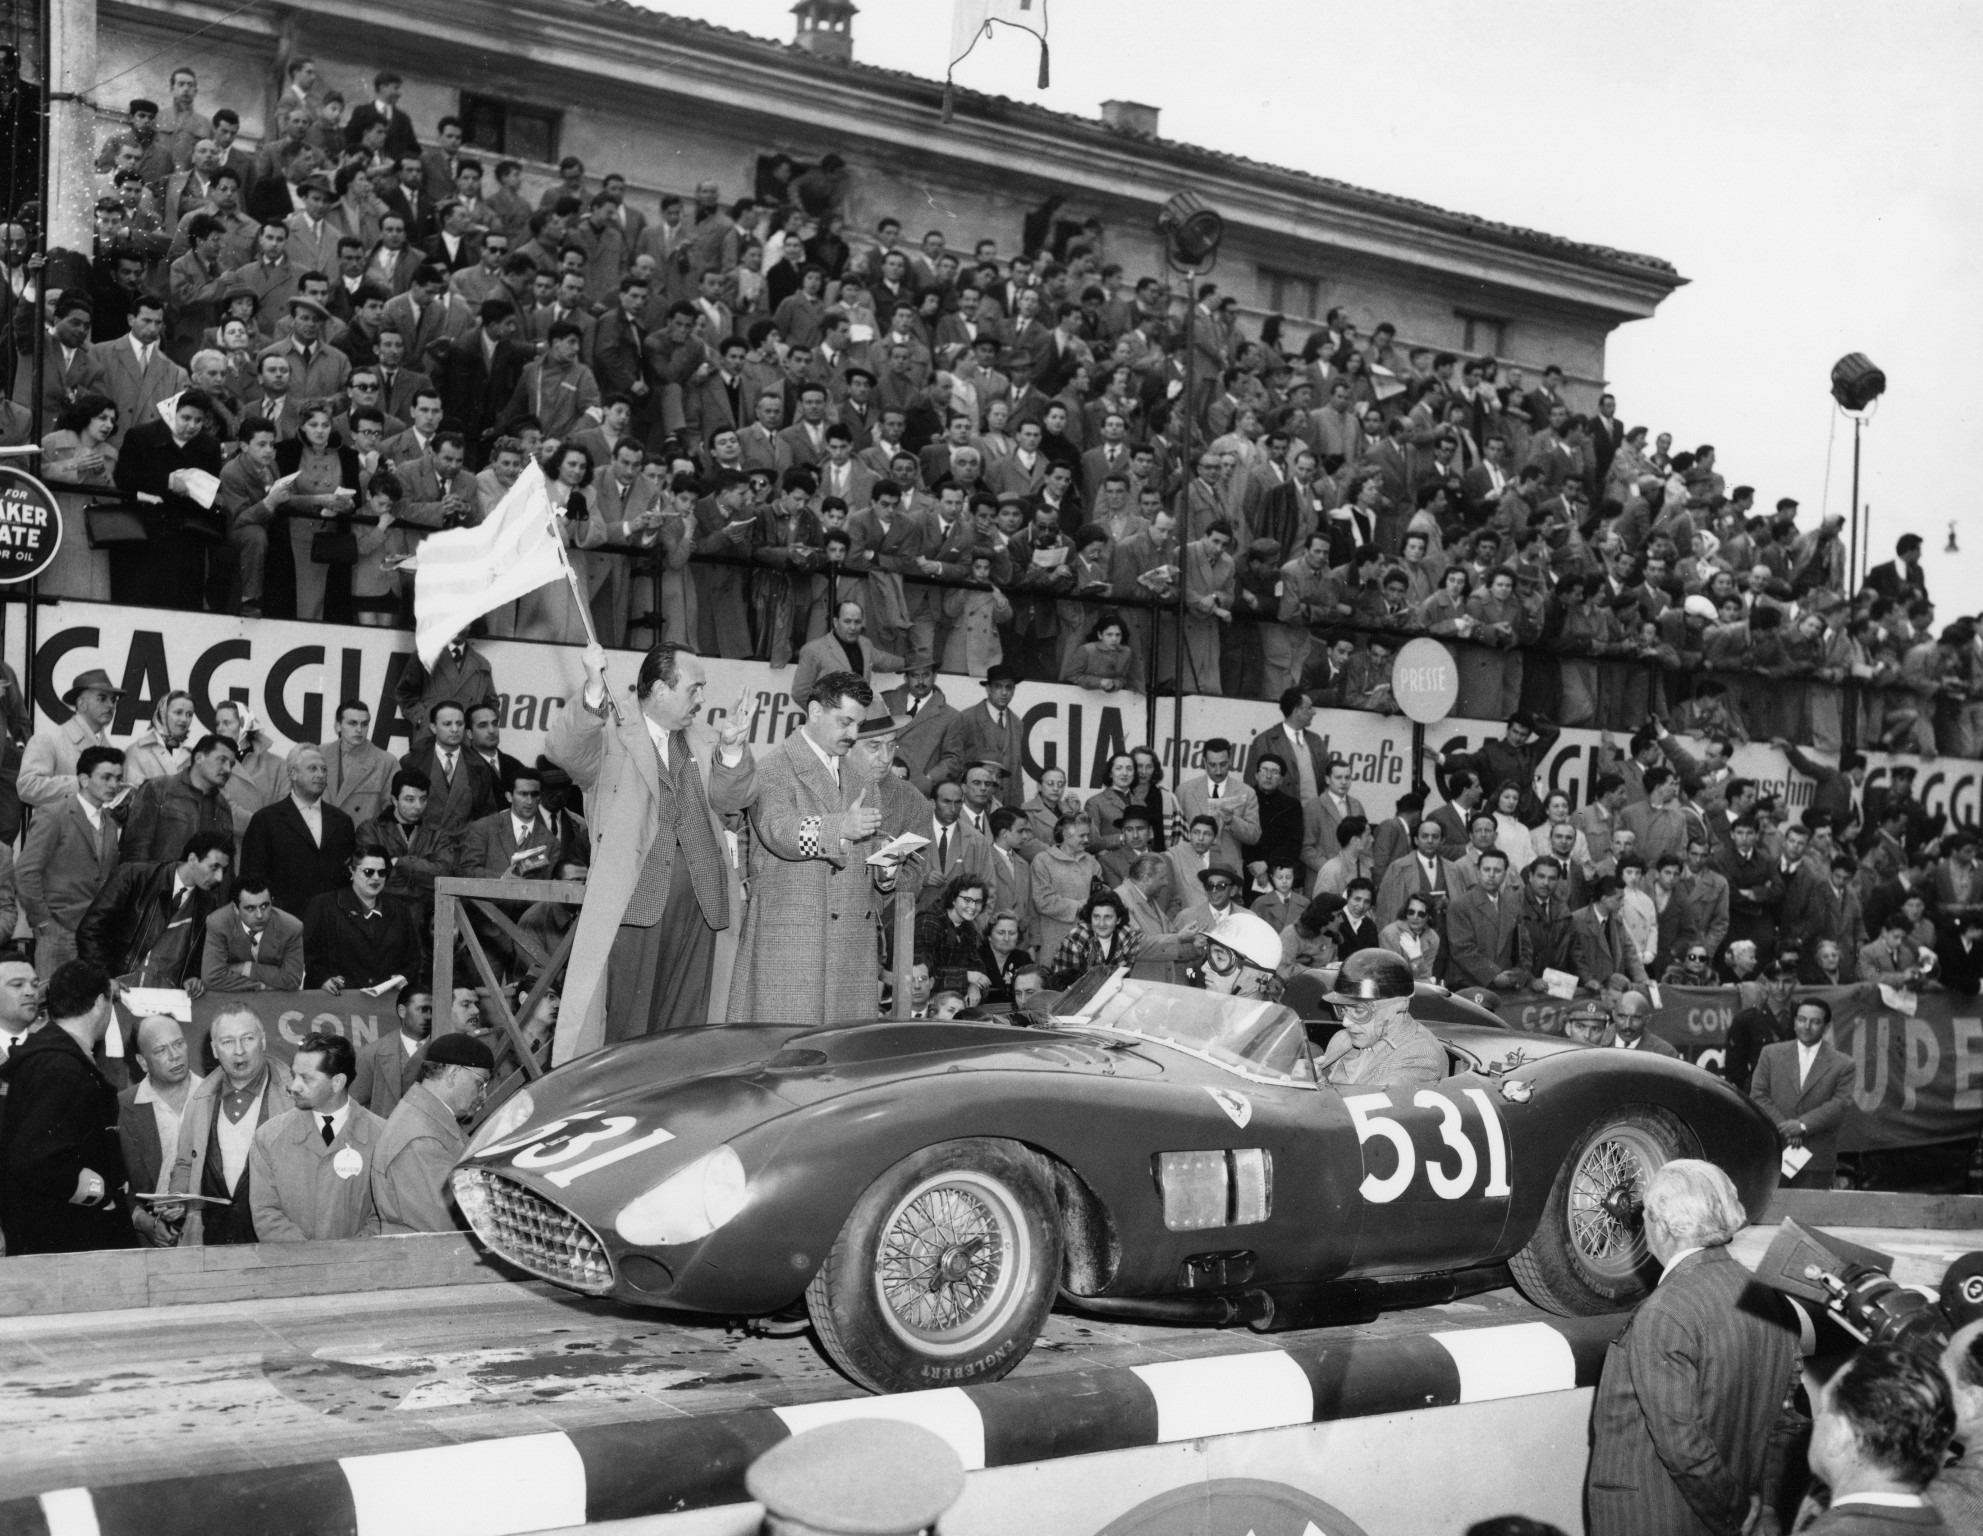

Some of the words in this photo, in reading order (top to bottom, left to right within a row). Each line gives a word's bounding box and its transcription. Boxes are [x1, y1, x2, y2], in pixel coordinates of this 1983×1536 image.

[4, 488, 28, 500] FOR
[0, 524, 41, 549] ATE
[15, 550, 34, 562] OIL
[1400, 666, 1446, 692] PRESSE
[1020, 701, 1127, 789] GIA
[1852, 1016, 1983, 1112] UPE
[474, 1110, 677, 1188] 531
[1343, 1088, 1512, 1204] 531
[920, 1338, 1016, 1380] ENGLEBERT
